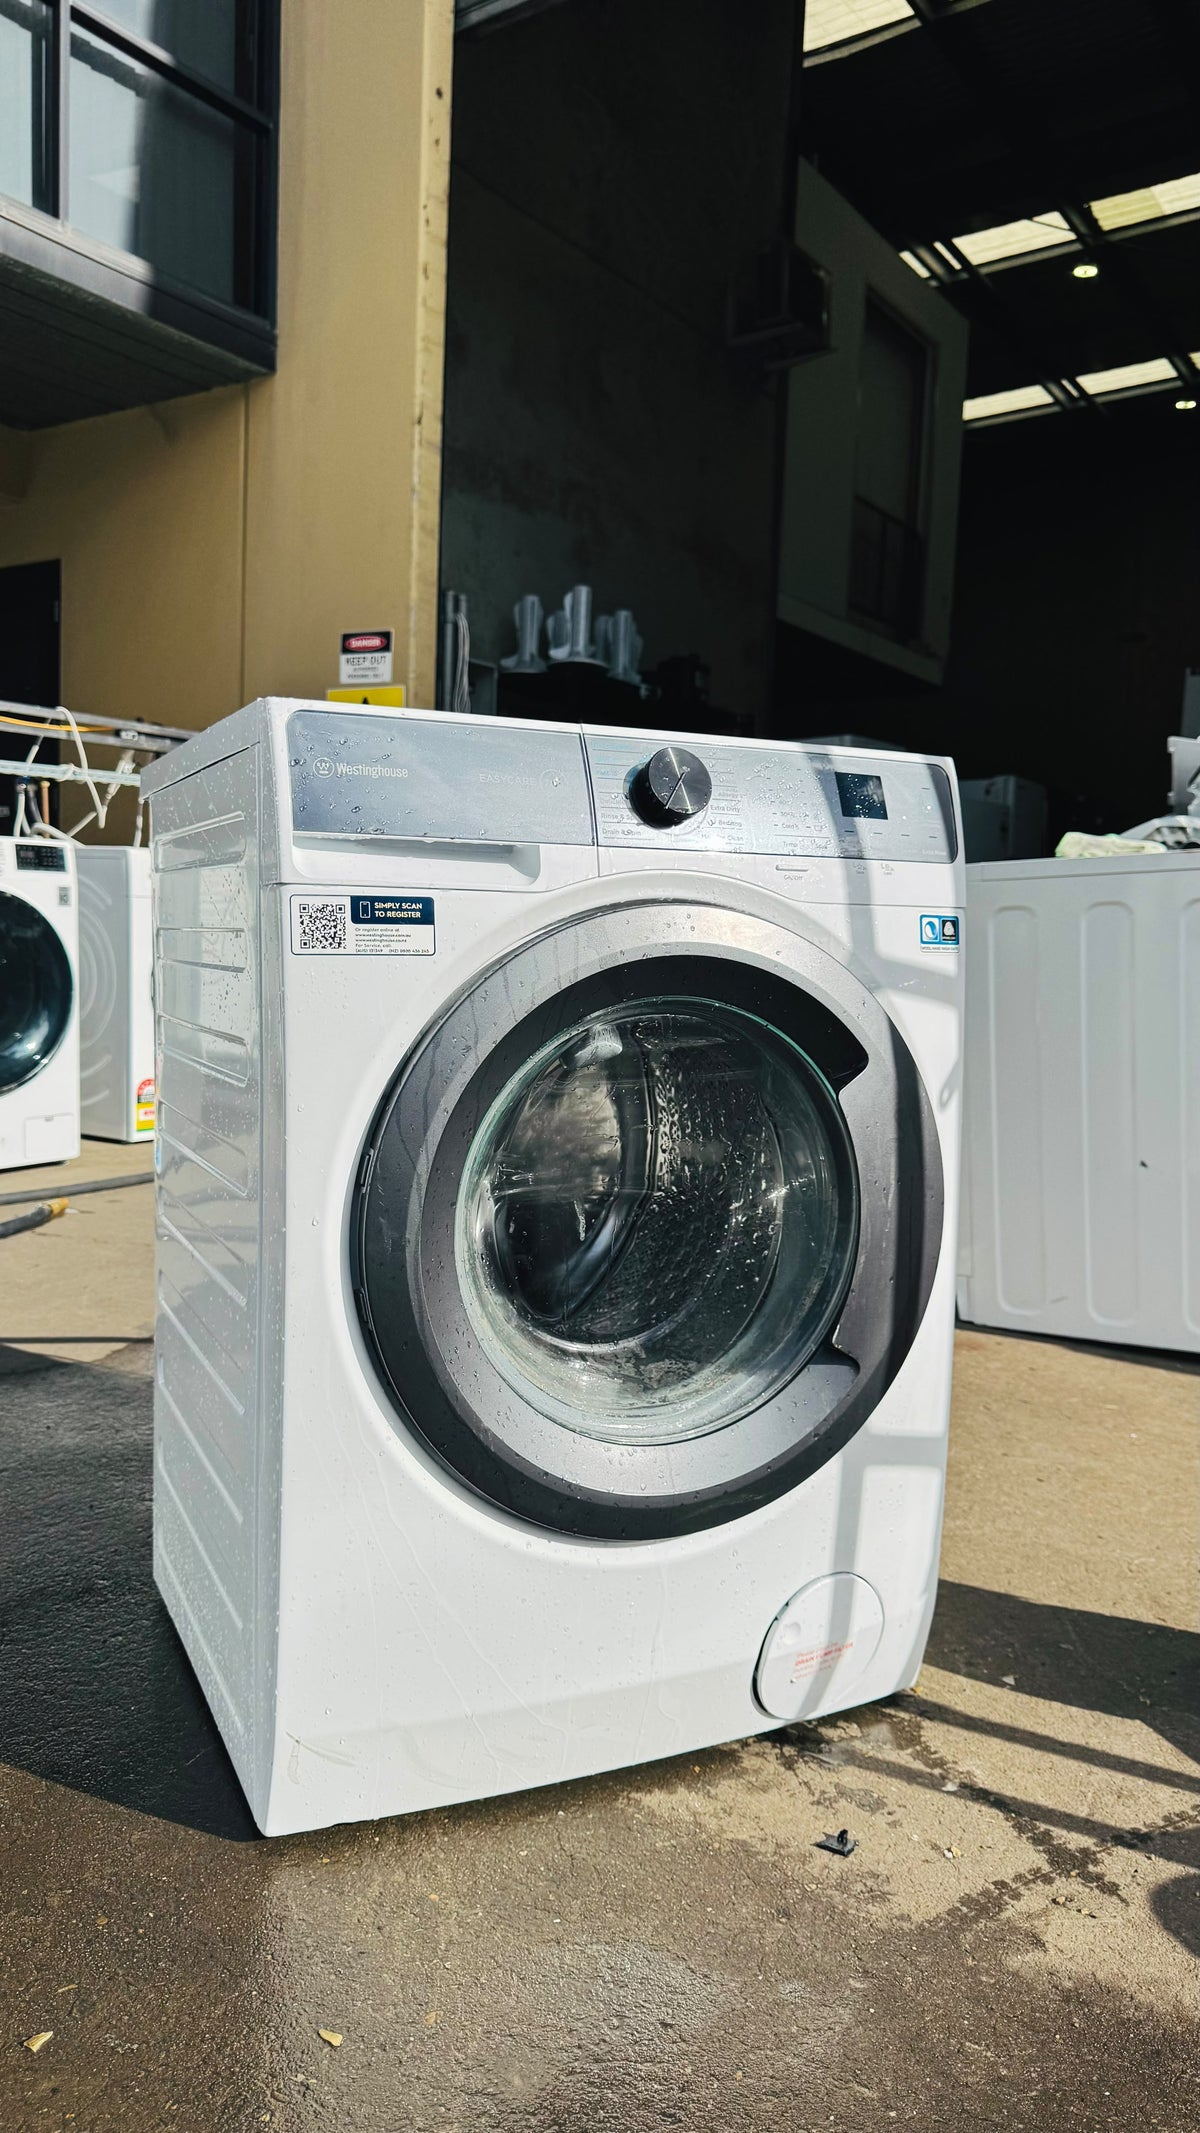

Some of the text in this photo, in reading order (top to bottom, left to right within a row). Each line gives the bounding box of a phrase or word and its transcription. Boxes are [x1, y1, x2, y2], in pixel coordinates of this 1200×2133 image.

[351, 639, 381, 648] DANGER
[346, 655, 386, 666] KEEP OUT
[336, 762, 409, 779] Westinghouse
[479, 773, 537, 786] EASYCARE
[401, 902, 423, 910] SCAN
[374, 910, 422, 919] TO REGISTER
